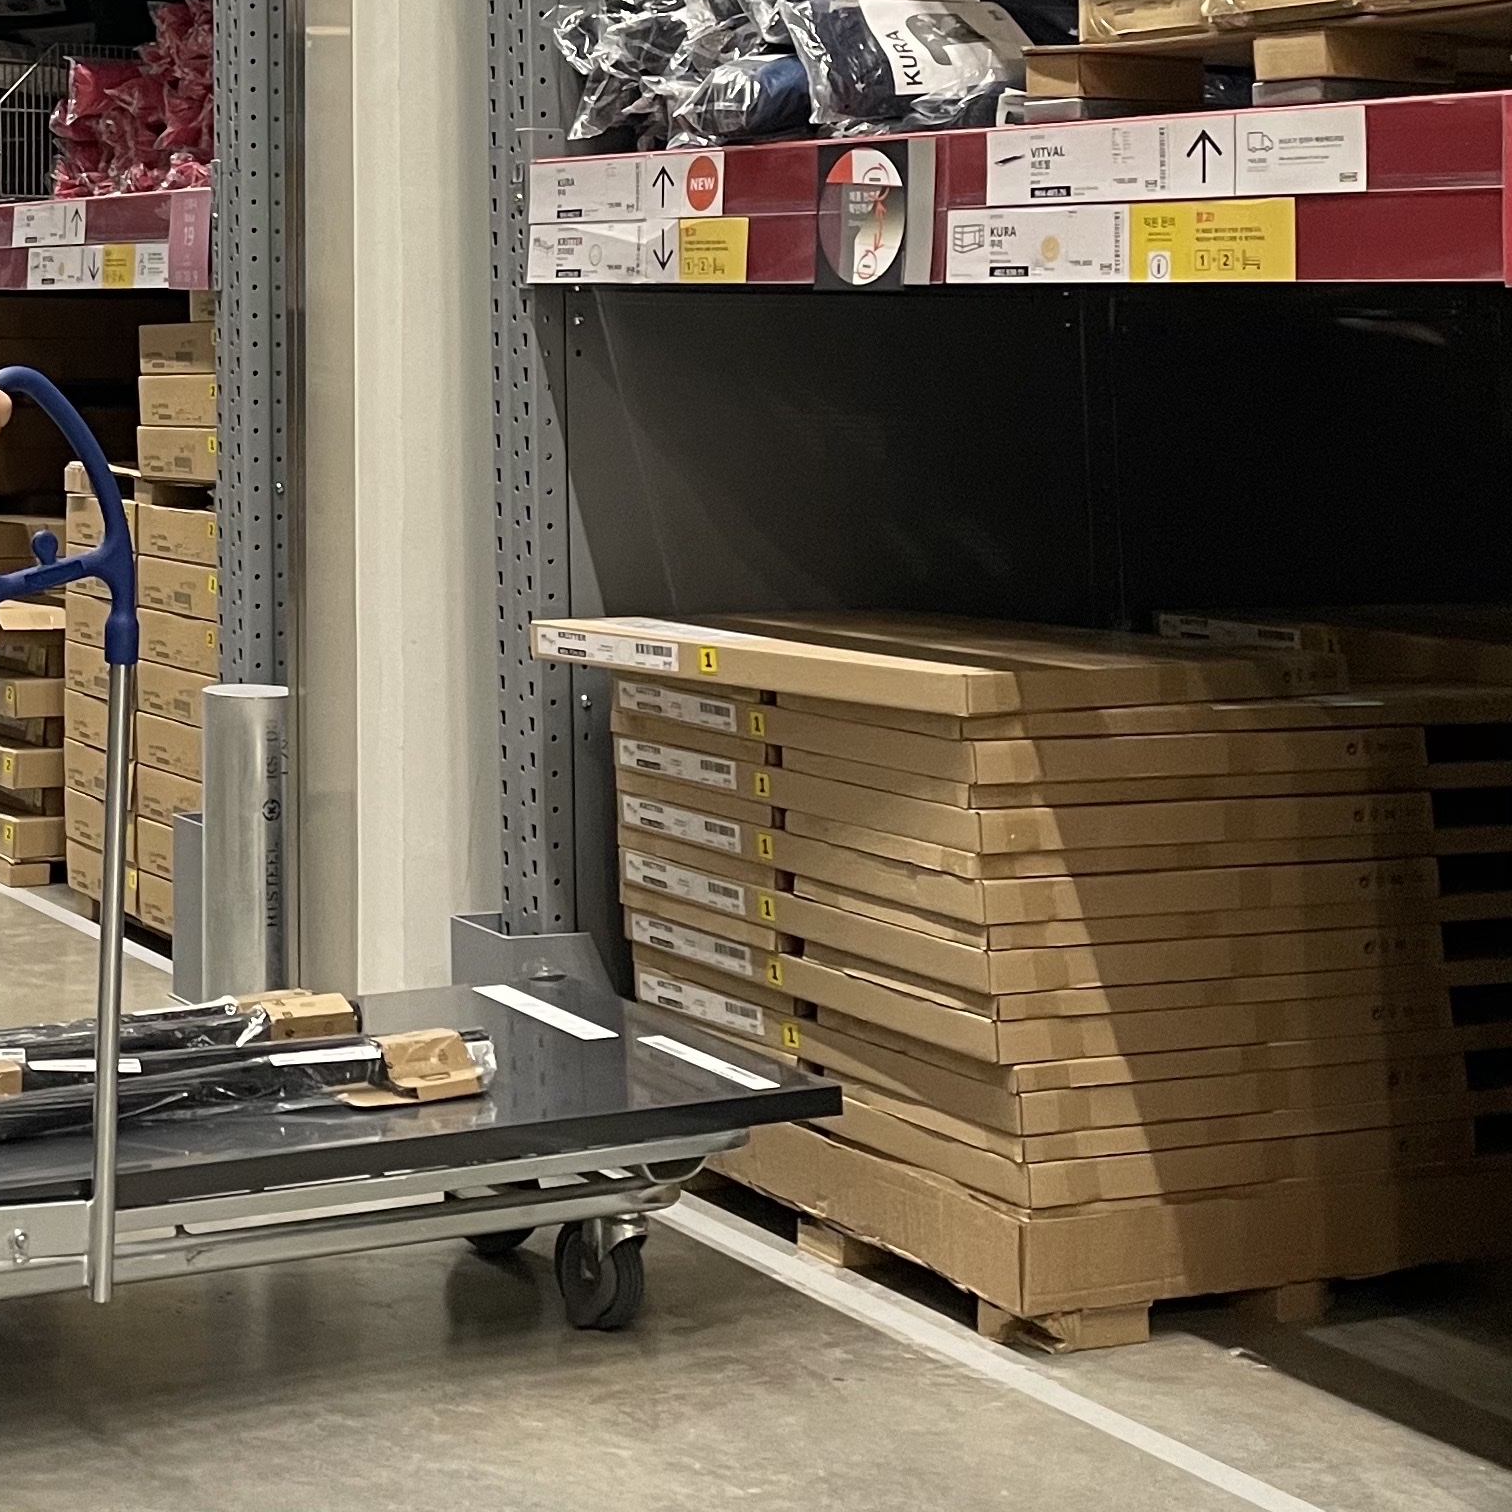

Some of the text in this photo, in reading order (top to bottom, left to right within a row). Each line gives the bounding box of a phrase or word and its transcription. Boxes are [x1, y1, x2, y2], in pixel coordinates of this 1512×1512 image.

[885, 30, 924, 86] KURA
[1030, 145, 1066, 159] VITVAL
[690, 177, 715, 191] NEW
[990, 226, 1017, 239] KURA
[1199, 254, 1230, 267] 1 2
[704, 651, 713, 668] 1
[754, 715, 761, 733] 1
[759, 777, 766, 793] 1
[762, 838, 769, 855] 1
[764, 899, 772, 917] 1
[772, 964, 779, 981] 1
[787, 1026, 796, 1044] 1
